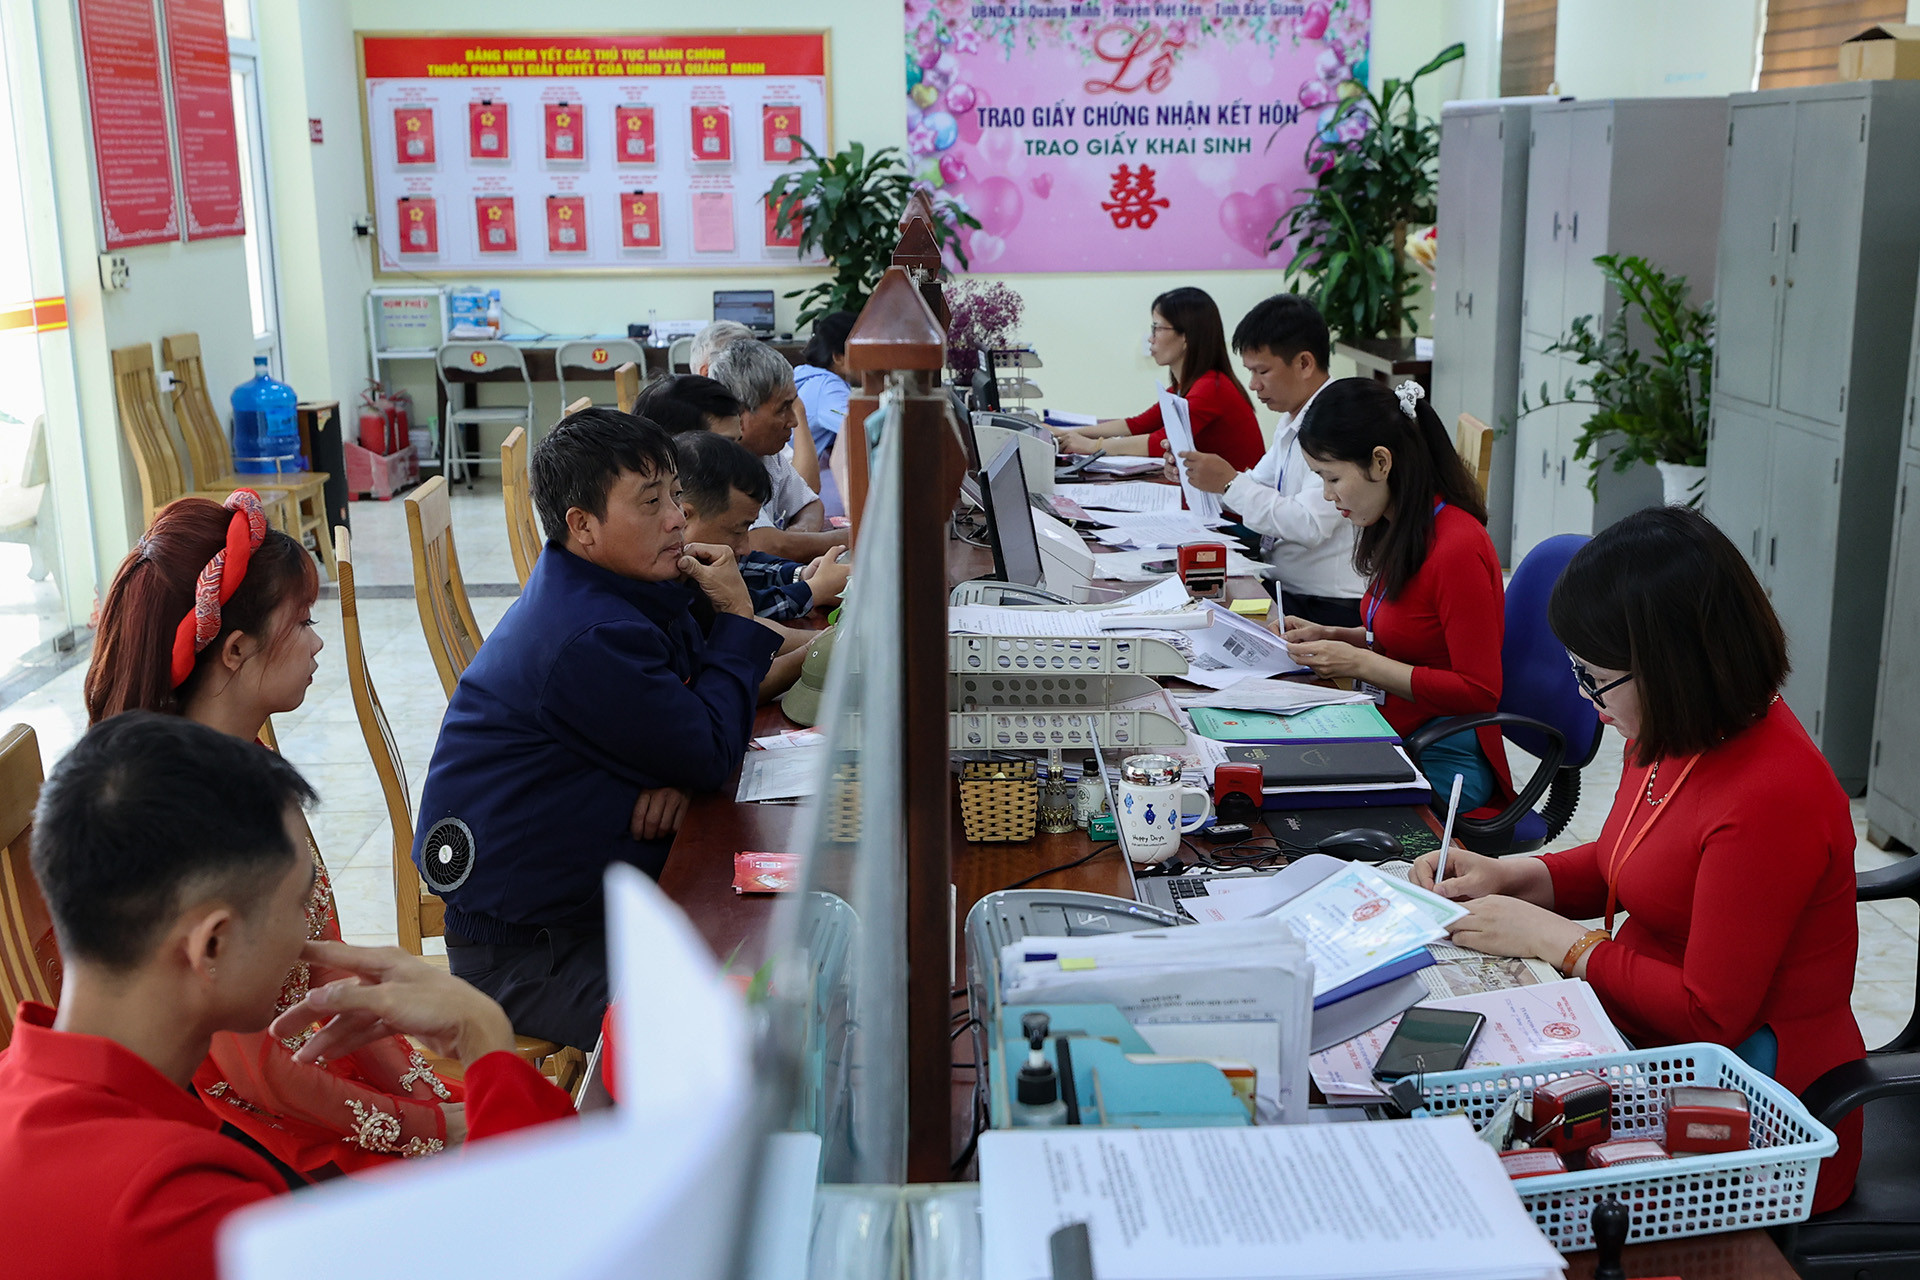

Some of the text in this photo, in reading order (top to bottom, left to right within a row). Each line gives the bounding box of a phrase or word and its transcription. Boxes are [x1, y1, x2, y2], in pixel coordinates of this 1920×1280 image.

[972, 4, 1006, 18] UBND
[1071, 4, 1101, 17] Minh
[1270, 2, 1305, 17] Giang
[464, 46, 501, 62] BẢNG
[564, 46, 592, 62] CÁC
[594, 45, 619, 61] THỦ
[648, 46, 684, 61] HÀNH
[685, 46, 726, 61] CHÍNH
[1084, 24, 1186, 95] Lễ
[427, 62, 469, 77] THUỘC
[511, 63, 525, 76] VI
[555, 60, 595, 77] QUYẾT
[597, 59, 625, 76] CỦA
[626, 62, 663, 76] UBND
[684, 60, 729, 76] QUẢNG
[730, 62, 766, 75] MINH
[977, 97, 1298, 131] TRAO GIẤY CHỨNG NHẬN KẾT HÔN
[1024, 130, 1251, 156] TRAO GIẤY KHAI SINH
